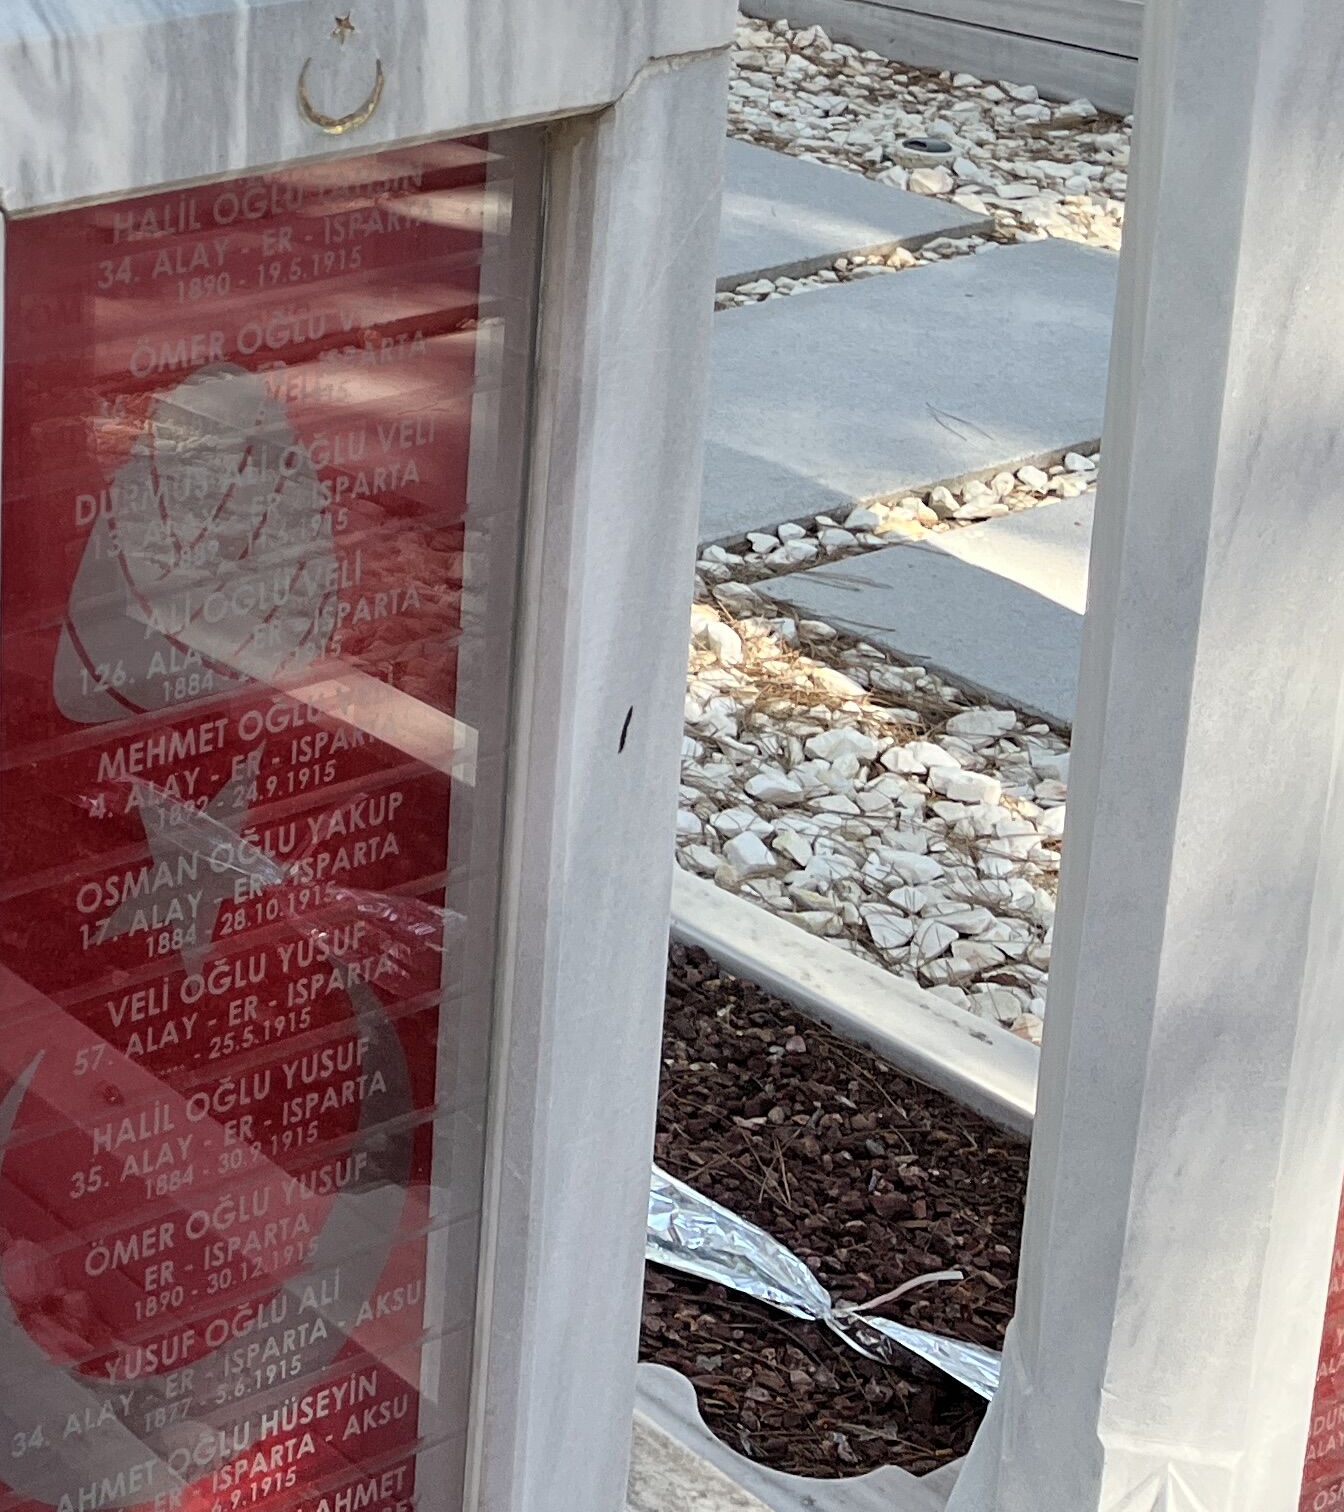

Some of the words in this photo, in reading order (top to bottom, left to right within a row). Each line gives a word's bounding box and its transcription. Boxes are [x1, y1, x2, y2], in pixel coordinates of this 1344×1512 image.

[151, 238, 230, 280] ALAY
[261, 226, 294, 255] ER
[130, 331, 225, 379] ÖMER
[236, 308, 327, 355] OĞLU
[313, 586, 422, 635] ISPARTA
[96, 718, 228, 785] MEHMET
[237, 692, 320, 742] OĞLU
[124, 767, 200, 814] ALAY
[231, 751, 261, 780] ER
[232, 759, 337, 808] 24.9.1915
[75, 849, 200, 914] OSMAN
[211, 821, 297, 874] OĞLU
[306, 791, 405, 845] YAKUP
[128, 889, 203, 936] ALAY
[232, 871, 264, 905] ER
[291, 831, 401, 888] ISPARTA
[220, 879, 338, 938] 28.10.1915
[72, 1043, 114, 1076] 57.
[125, 1011, 199, 1059] ALAY
[228, 994, 259, 1026] ER
[288, 954, 395, 1009] ISPARTA
[105, 977, 170, 1029] VELİ
[179, 952, 267, 1005] OĞLU
[277, 920, 367, 975] YUSUF
[208, 1006, 312, 1060] 25.5.1915
[68, 1165, 110, 1201] 35.
[120, 1134, 193, 1183] ALAY
[223, 1113, 253, 1146] ER
[281, 1070, 388, 1127] ISPARTA
[92, 1097, 176, 1156] HALİL
[185, 1068, 272, 1122] OĞLU
[282, 1037, 368, 1089] YUSUF
[216, 1120, 320, 1174] 30.9.1915
[84, 1224, 175, 1278] ÖMER
[185, 1186, 270, 1240] OĞLU
[282, 1152, 368, 1206] YUSUF
[144, 1259, 176, 1291] ER
[202, 1210, 310, 1271] ISPARTA
[134, 1286, 185, 1321] 1890
[205, 1237, 321, 1294] 30.12.1915
[12, 1422, 51, 1458] 34.
[63, 1388, 136, 1439] ALAY
[165, 1366, 195, 1400] ER
[223, 1316, 329, 1378] ISPARTA
[354, 1278, 423, 1326] AKSU
[105, 1328, 196, 1380] YUSUF
[204, 1293, 287, 1347] OĞLU
[56, 1459, 157, 1512] AHMET
[166, 1419, 252, 1474] OĞLU
[261, 1368, 377, 1442] HÜSEYİN
[212, 1432, 315, 1494] ISPARTA
[342, 1395, 409, 1441] AKSU
[315, 1464, 408, 1512] AHMET
